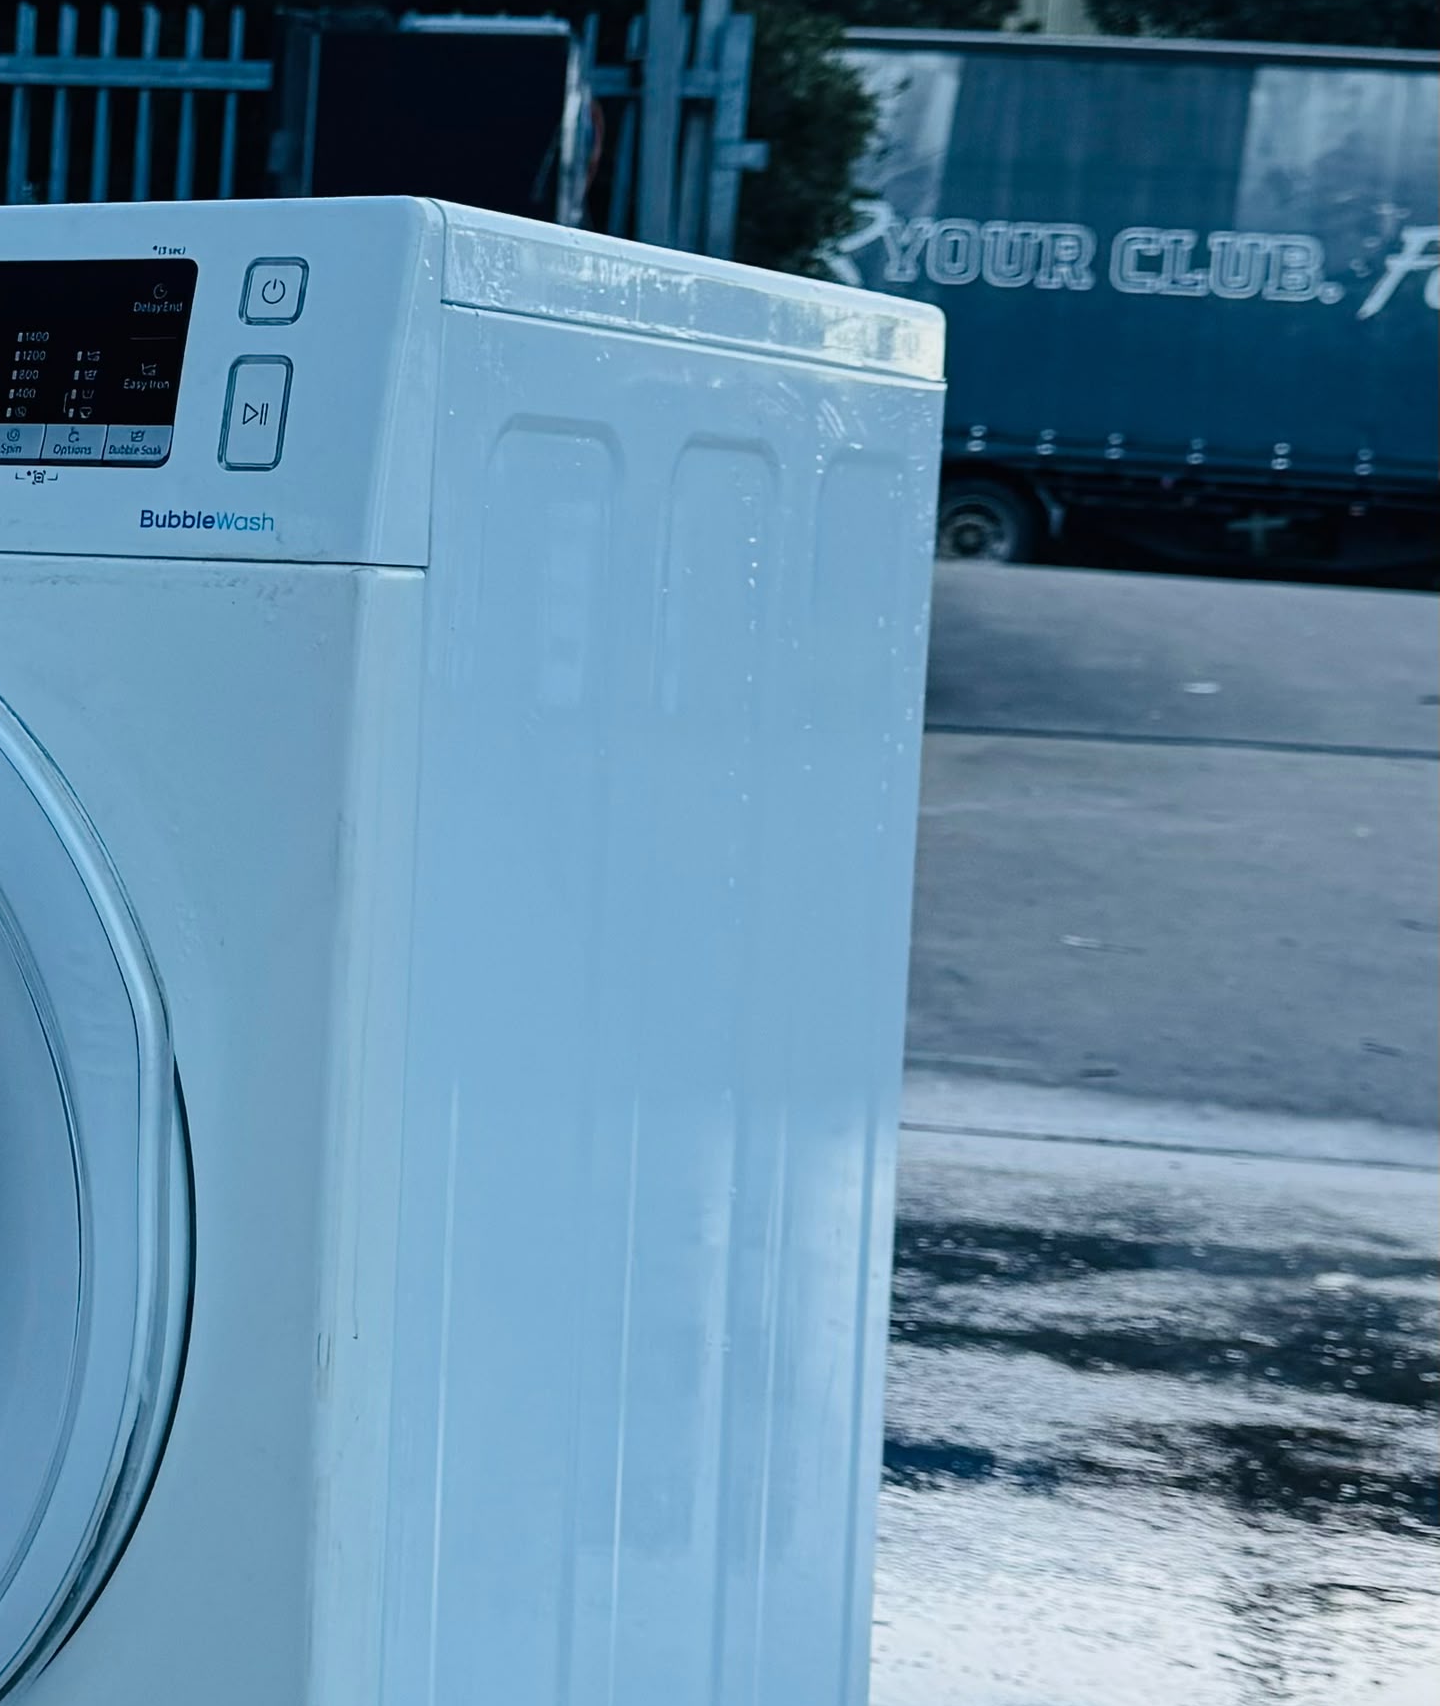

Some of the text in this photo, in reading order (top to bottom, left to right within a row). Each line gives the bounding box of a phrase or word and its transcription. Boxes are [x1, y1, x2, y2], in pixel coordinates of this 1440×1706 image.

[881, 217, 1097, 290] YOUR
[1108, 225, 1344, 305] CLUB.
[25, 331, 50, 342] 1400
[22, 350, 47, 361] 1200
[123, 378, 147, 392] Easy
[0, 443, 22, 455] Spin
[53, 443, 92, 455] Options
[139, 509, 275, 532] BubbleWash
